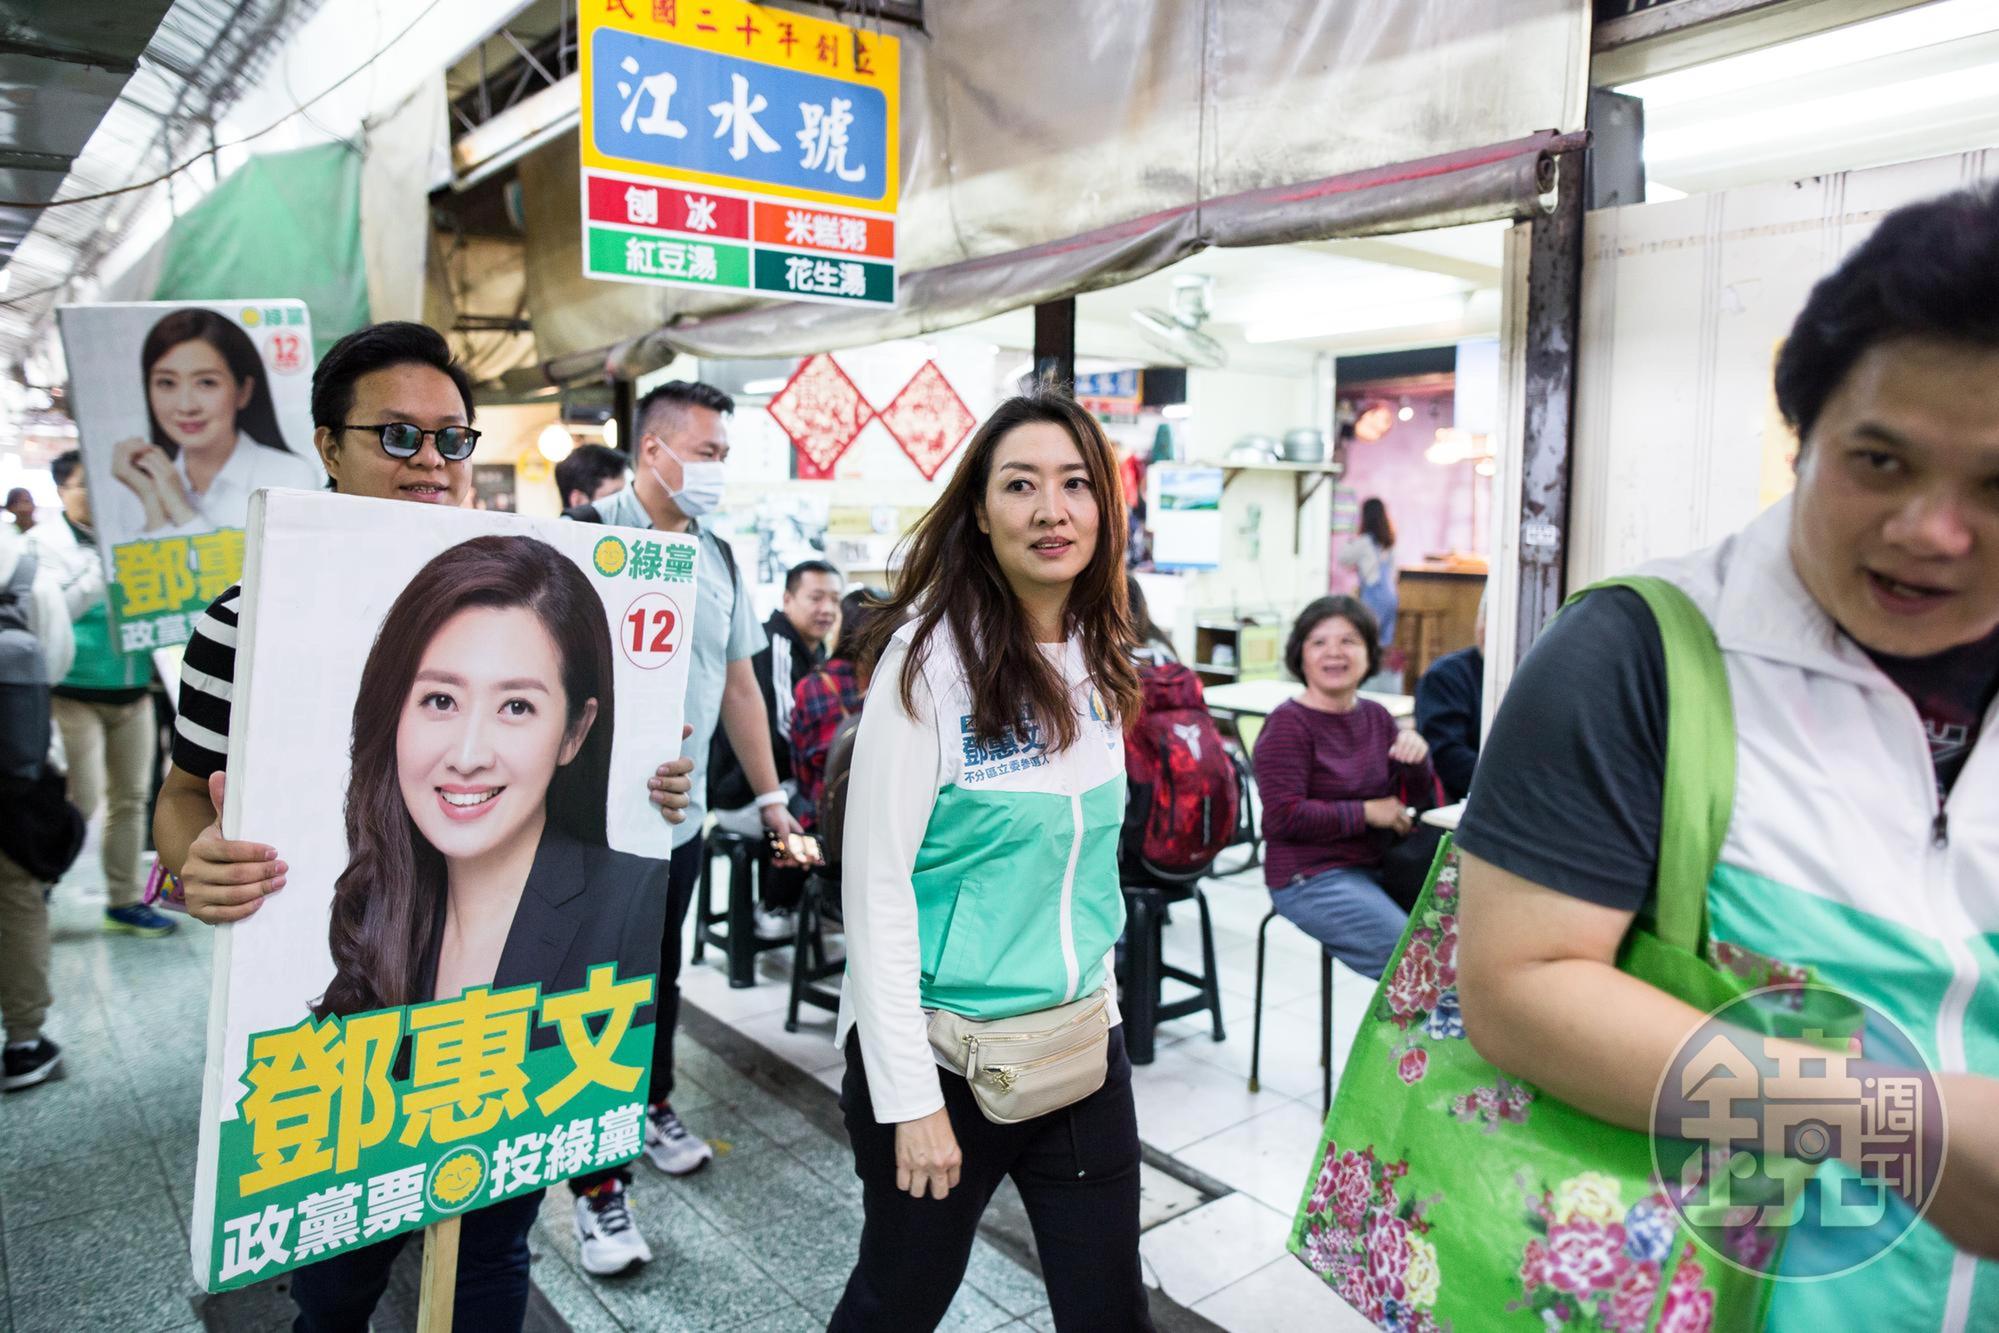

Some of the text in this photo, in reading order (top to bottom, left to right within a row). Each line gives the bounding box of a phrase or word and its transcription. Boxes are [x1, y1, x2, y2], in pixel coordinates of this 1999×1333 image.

[616, 55, 866, 182] 江水號
[785, 210, 867, 251] 米糕粥
[625, 237, 717, 280] 紅豆湯
[785, 256, 866, 297] 花生湯
[628, 540, 697, 582] 綠黨
[628, 608, 676, 653] 12
[239, 966, 653, 1198] 鄧惠文
[219, 1102, 645, 1283] 政黨票 投綠黨
